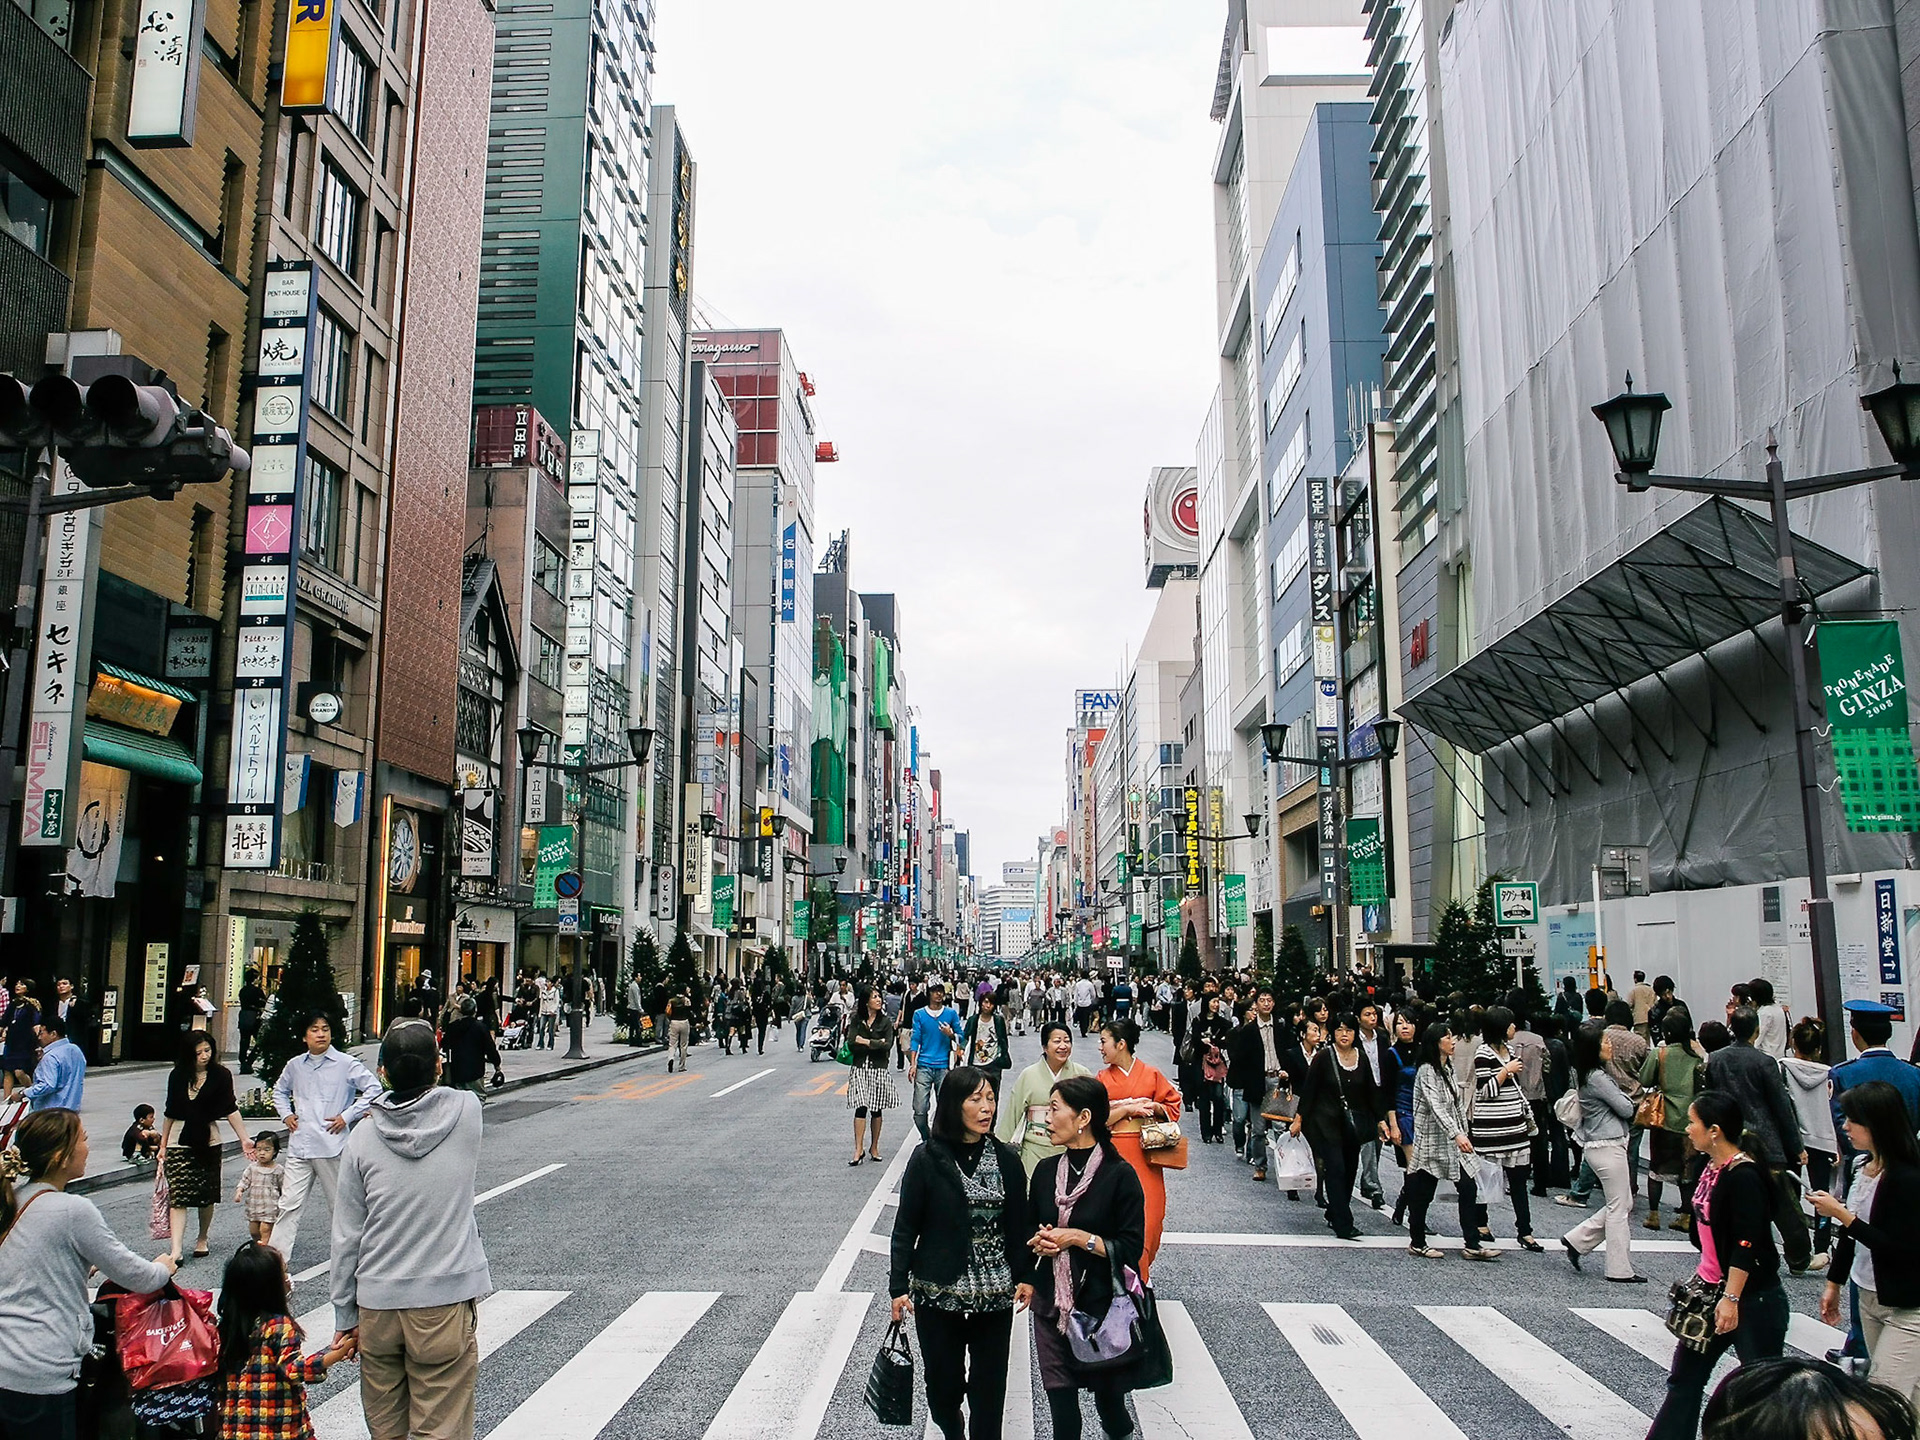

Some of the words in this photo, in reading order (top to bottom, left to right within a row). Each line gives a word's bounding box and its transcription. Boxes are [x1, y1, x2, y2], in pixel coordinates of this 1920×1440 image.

[283, 262, 295, 270] 9F
[278, 319, 291, 327] 8F
[691, 337, 759, 362] erragamo
[269, 435, 282, 443] 6F
[513, 409, 528, 458] 立田野
[260, 555, 273, 563] 4F
[57, 569, 74, 577] 2F
[782, 538, 795, 610] 名鉄観光
[56, 585, 68, 611] 銀座
[1312, 573, 1331, 621] ダンス
[256, 616, 269, 624] 3F
[44, 623, 71, 705] セキネ
[252, 679, 265, 687] 2F
[1824, 653, 1895, 698] PROMENADE
[1839, 673, 1906, 718] GINZA
[1866, 699, 1894, 719] 2008
[23, 721, 49, 839] SUMIYA
[1861, 813, 1903, 821] www.ginza.jp
[231, 832, 268, 851] 北斗
[1353, 839, 1381, 860] GINZA
[233, 852, 265, 861] 銀座店
[541, 846, 570, 864] GINZA
[661, 883, 669, 914] とらや
[1227, 886, 1246, 898] GINZA
[1880, 891, 1894, 957] 日新堂
